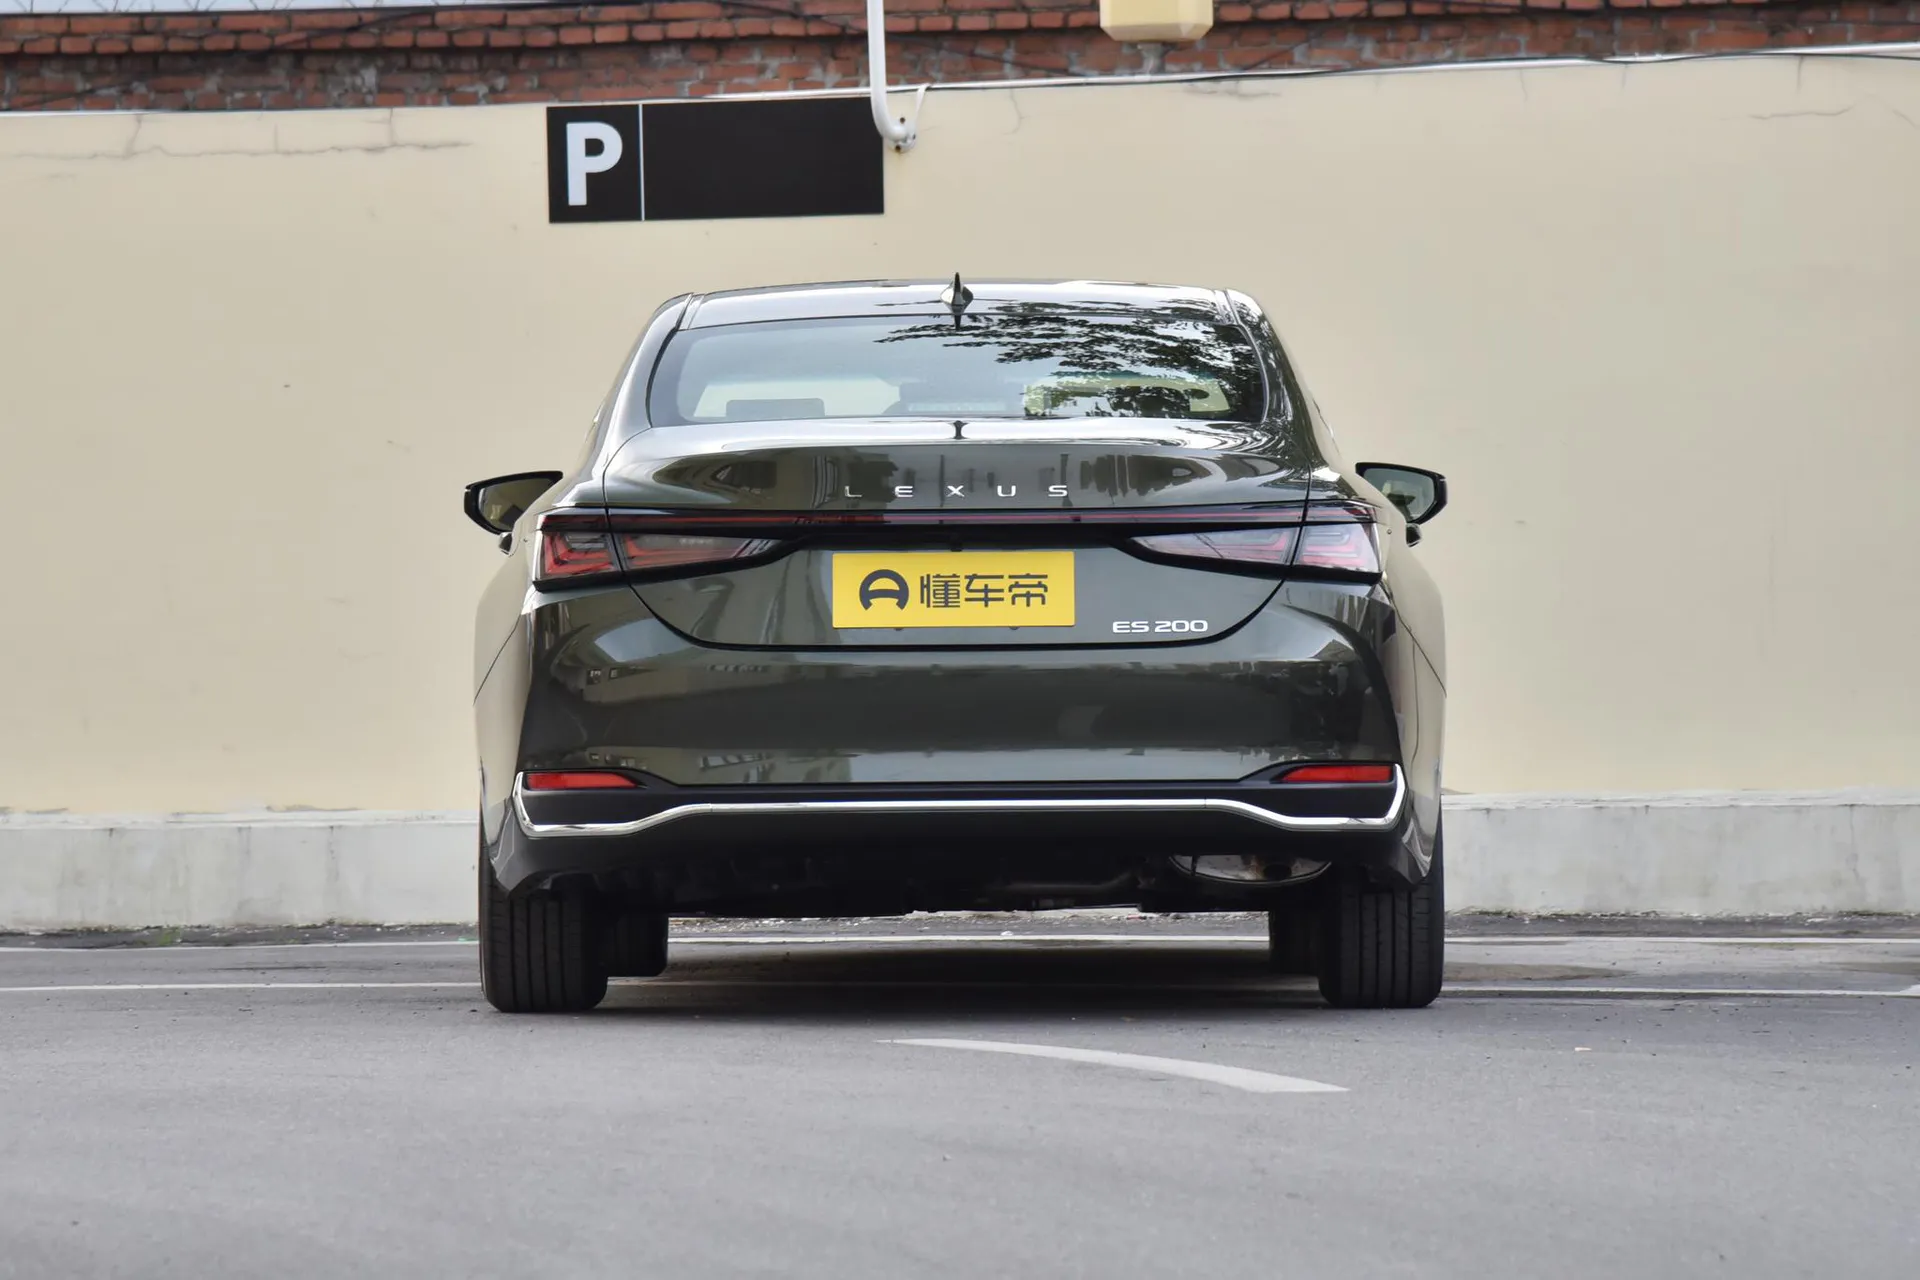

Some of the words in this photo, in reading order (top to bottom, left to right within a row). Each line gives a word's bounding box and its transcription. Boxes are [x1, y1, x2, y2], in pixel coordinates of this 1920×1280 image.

[566, 121, 623, 206] P
[844, 484, 1069, 498] LEXUS
[919, 573, 1048, 609] 懂车帝
[1112, 620, 1150, 633] ES
[1154, 619, 1209, 633] 200
